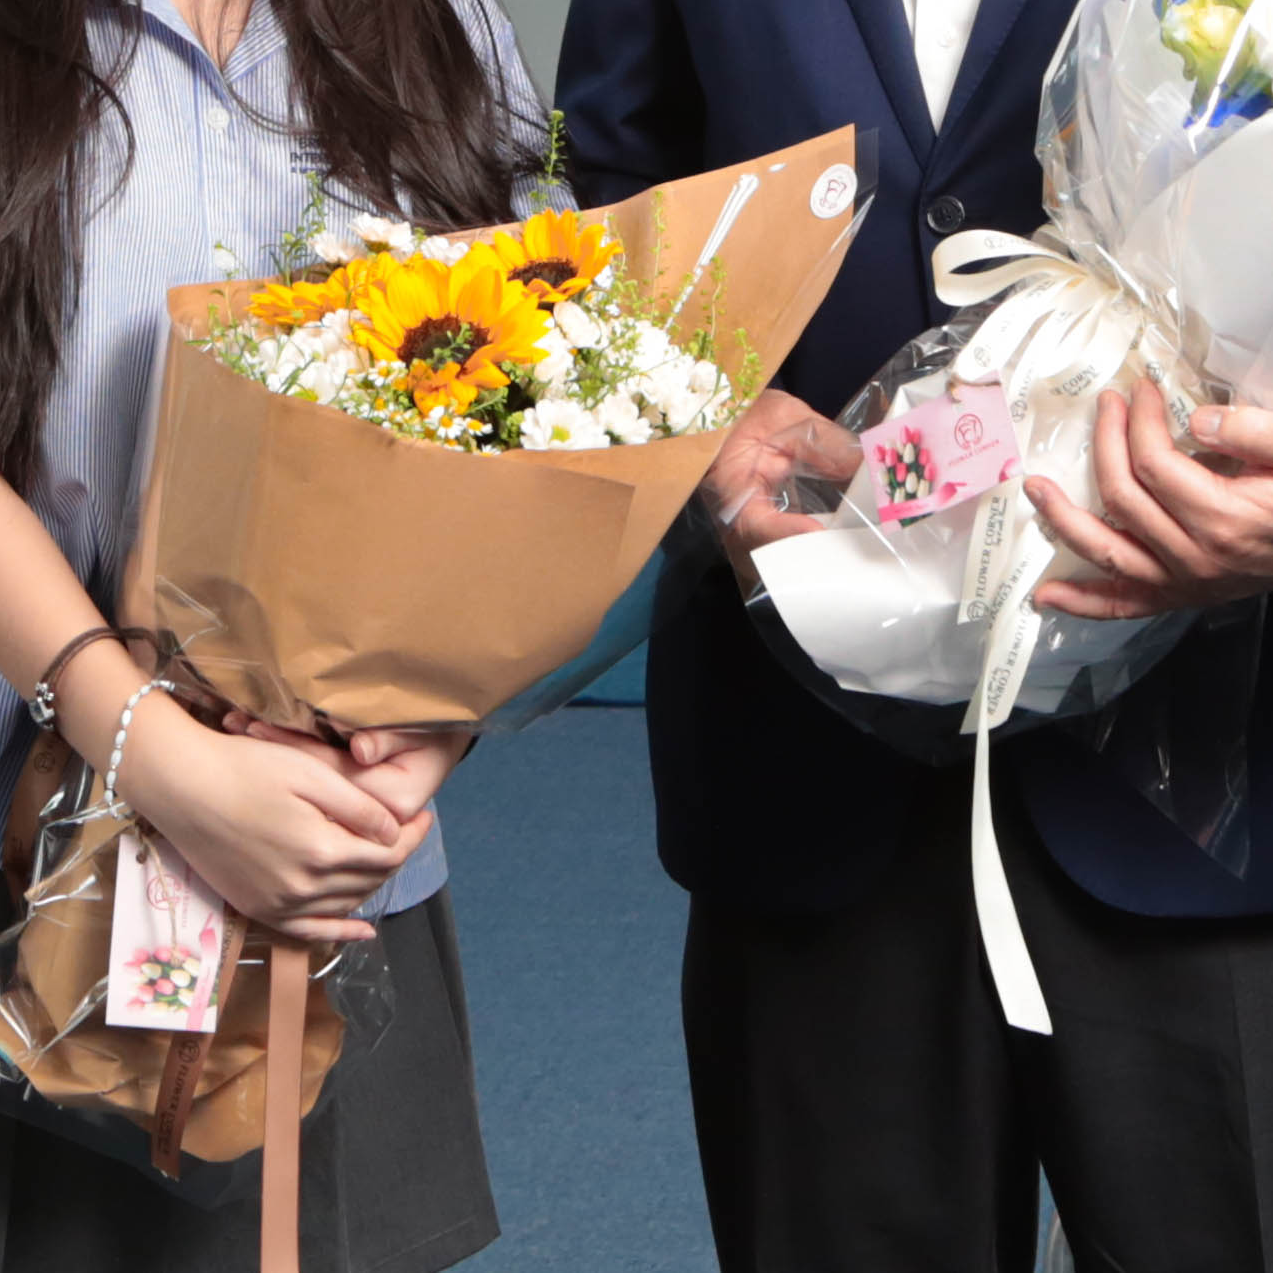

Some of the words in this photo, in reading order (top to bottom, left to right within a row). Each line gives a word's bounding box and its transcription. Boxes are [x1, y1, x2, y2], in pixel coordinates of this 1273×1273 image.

[975, 548, 992, 599] FLOWER
[984, 496, 1001, 547] CORNER
[1006, 613, 1028, 667] FLOWER
[987, 668, 1012, 717] CORNER
